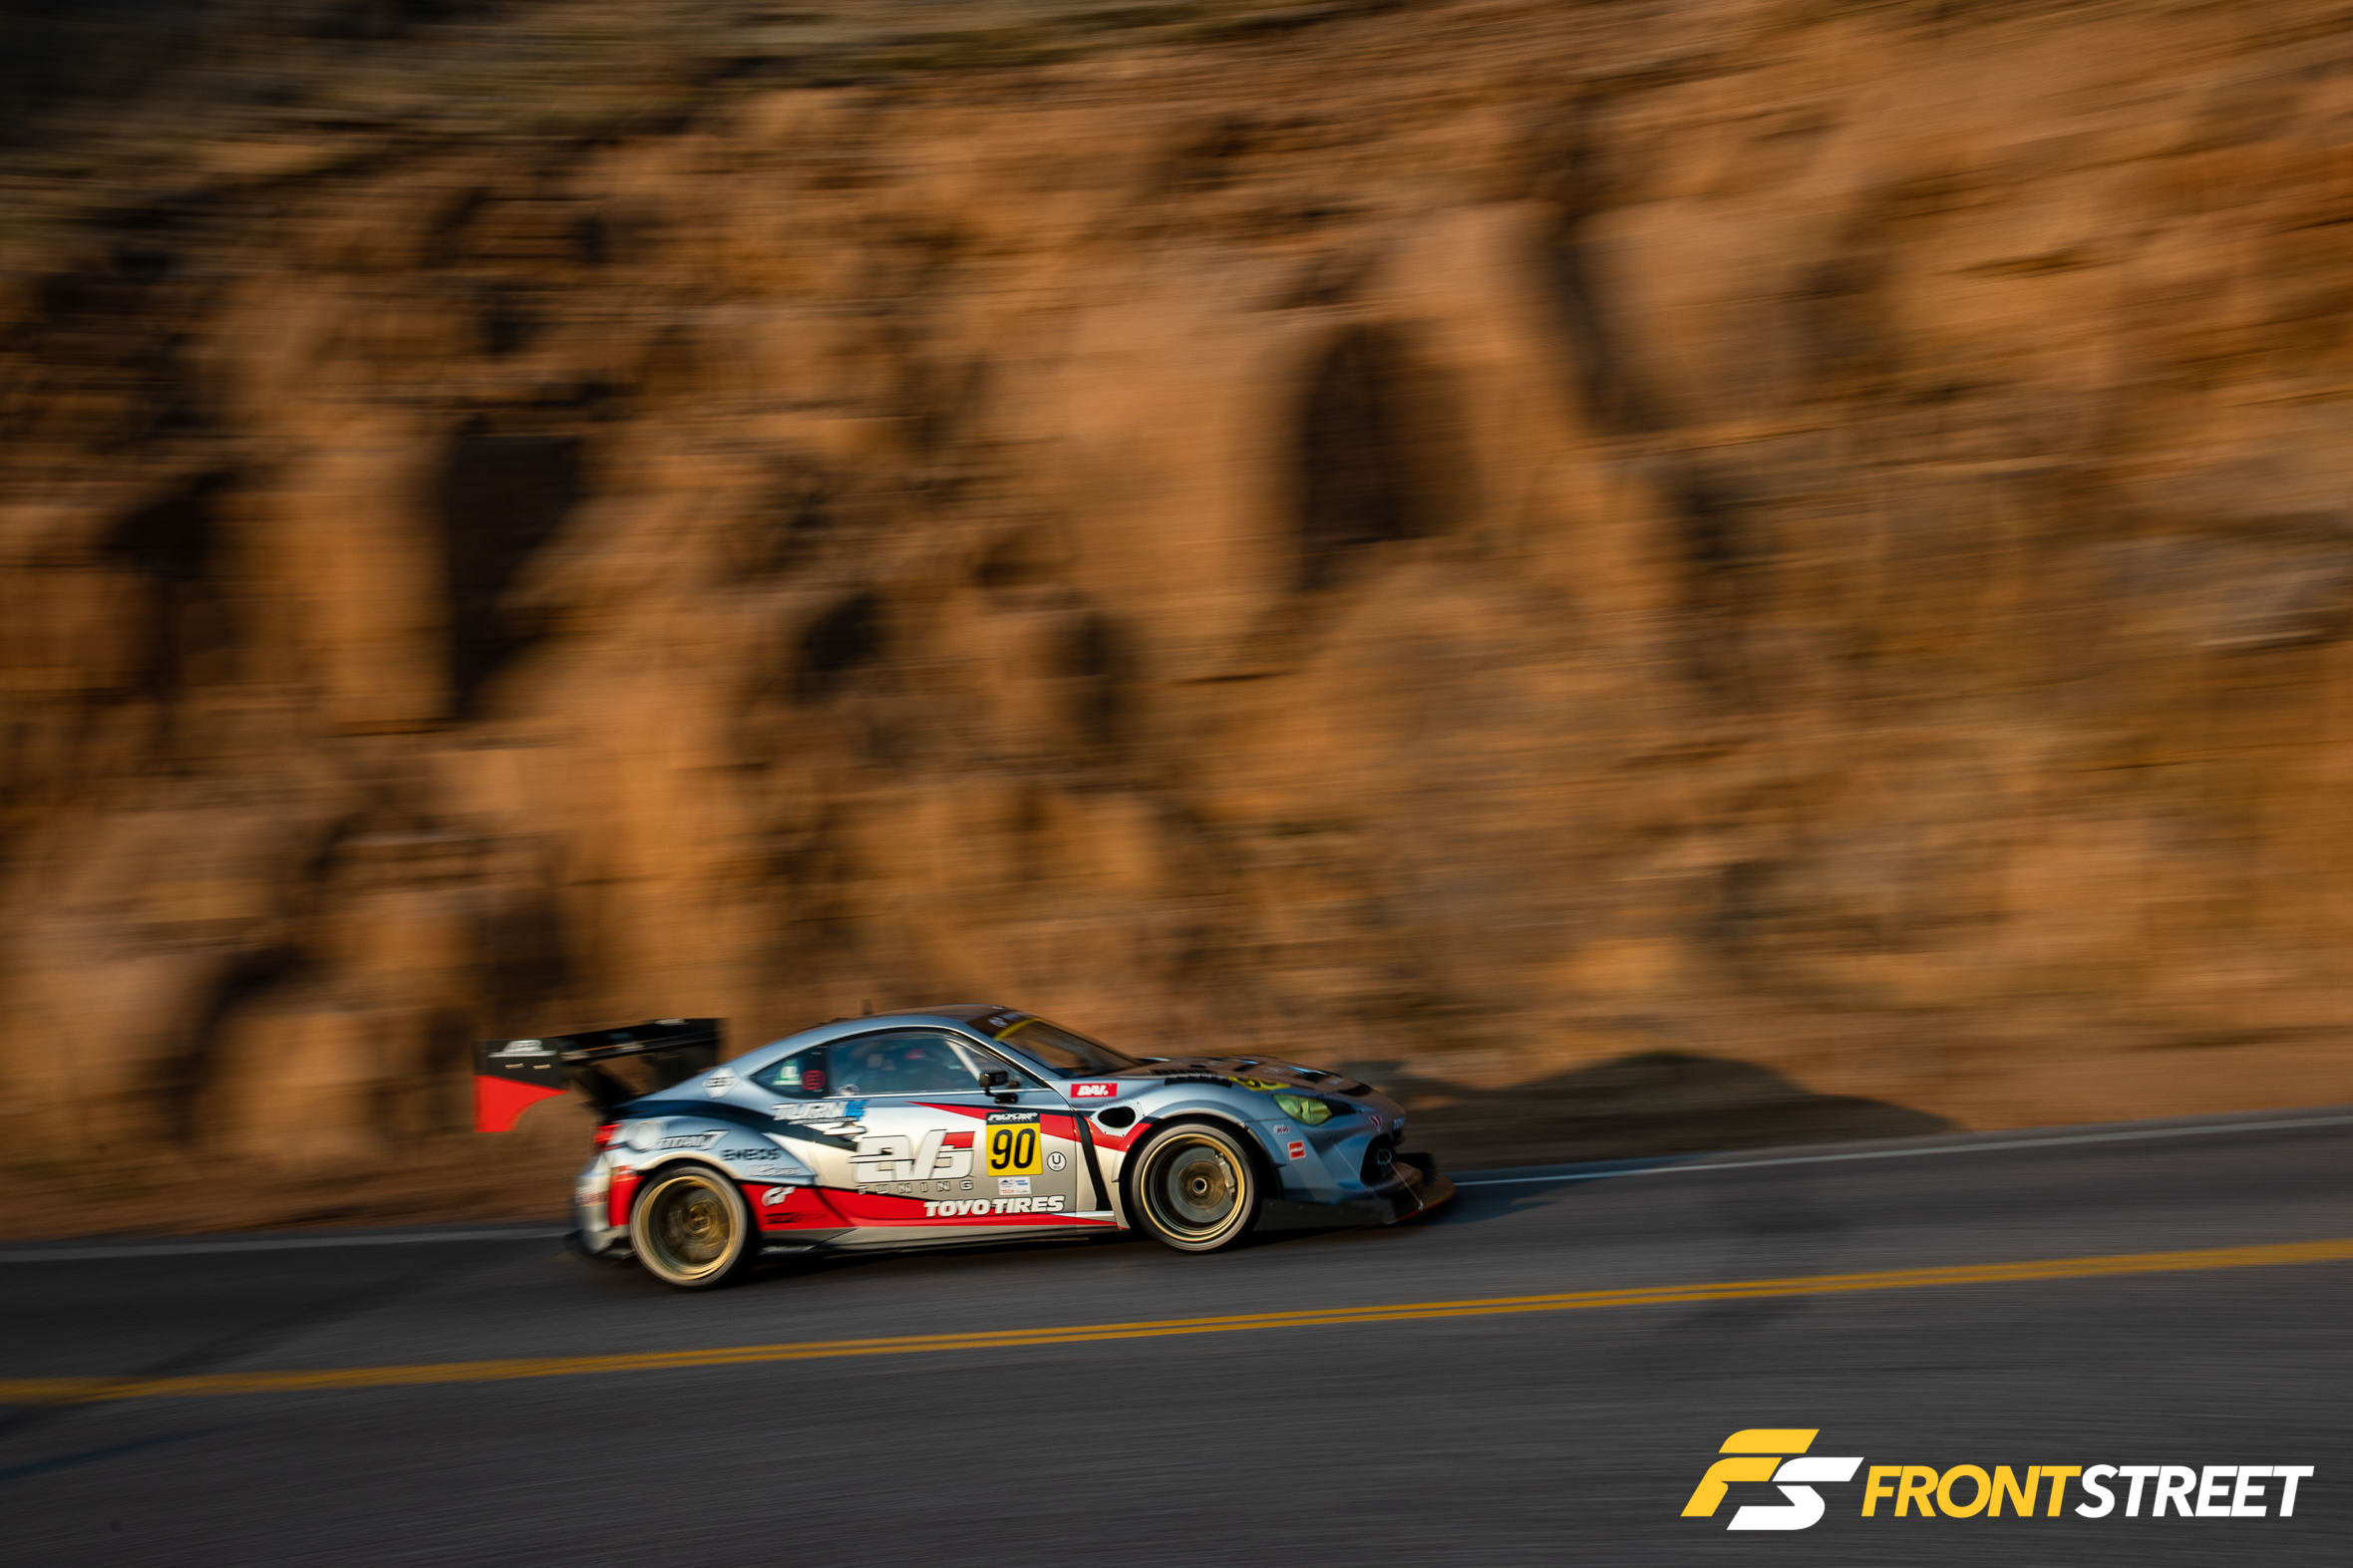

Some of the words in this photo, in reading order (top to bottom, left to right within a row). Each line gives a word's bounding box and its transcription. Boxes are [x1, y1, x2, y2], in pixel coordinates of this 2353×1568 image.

[990, 1127, 1036, 1170] 90
[855, 1180, 974, 1195] TUNING
[923, 1198, 991, 1217] TOYO
[992, 1195, 1066, 1214] TIRES
